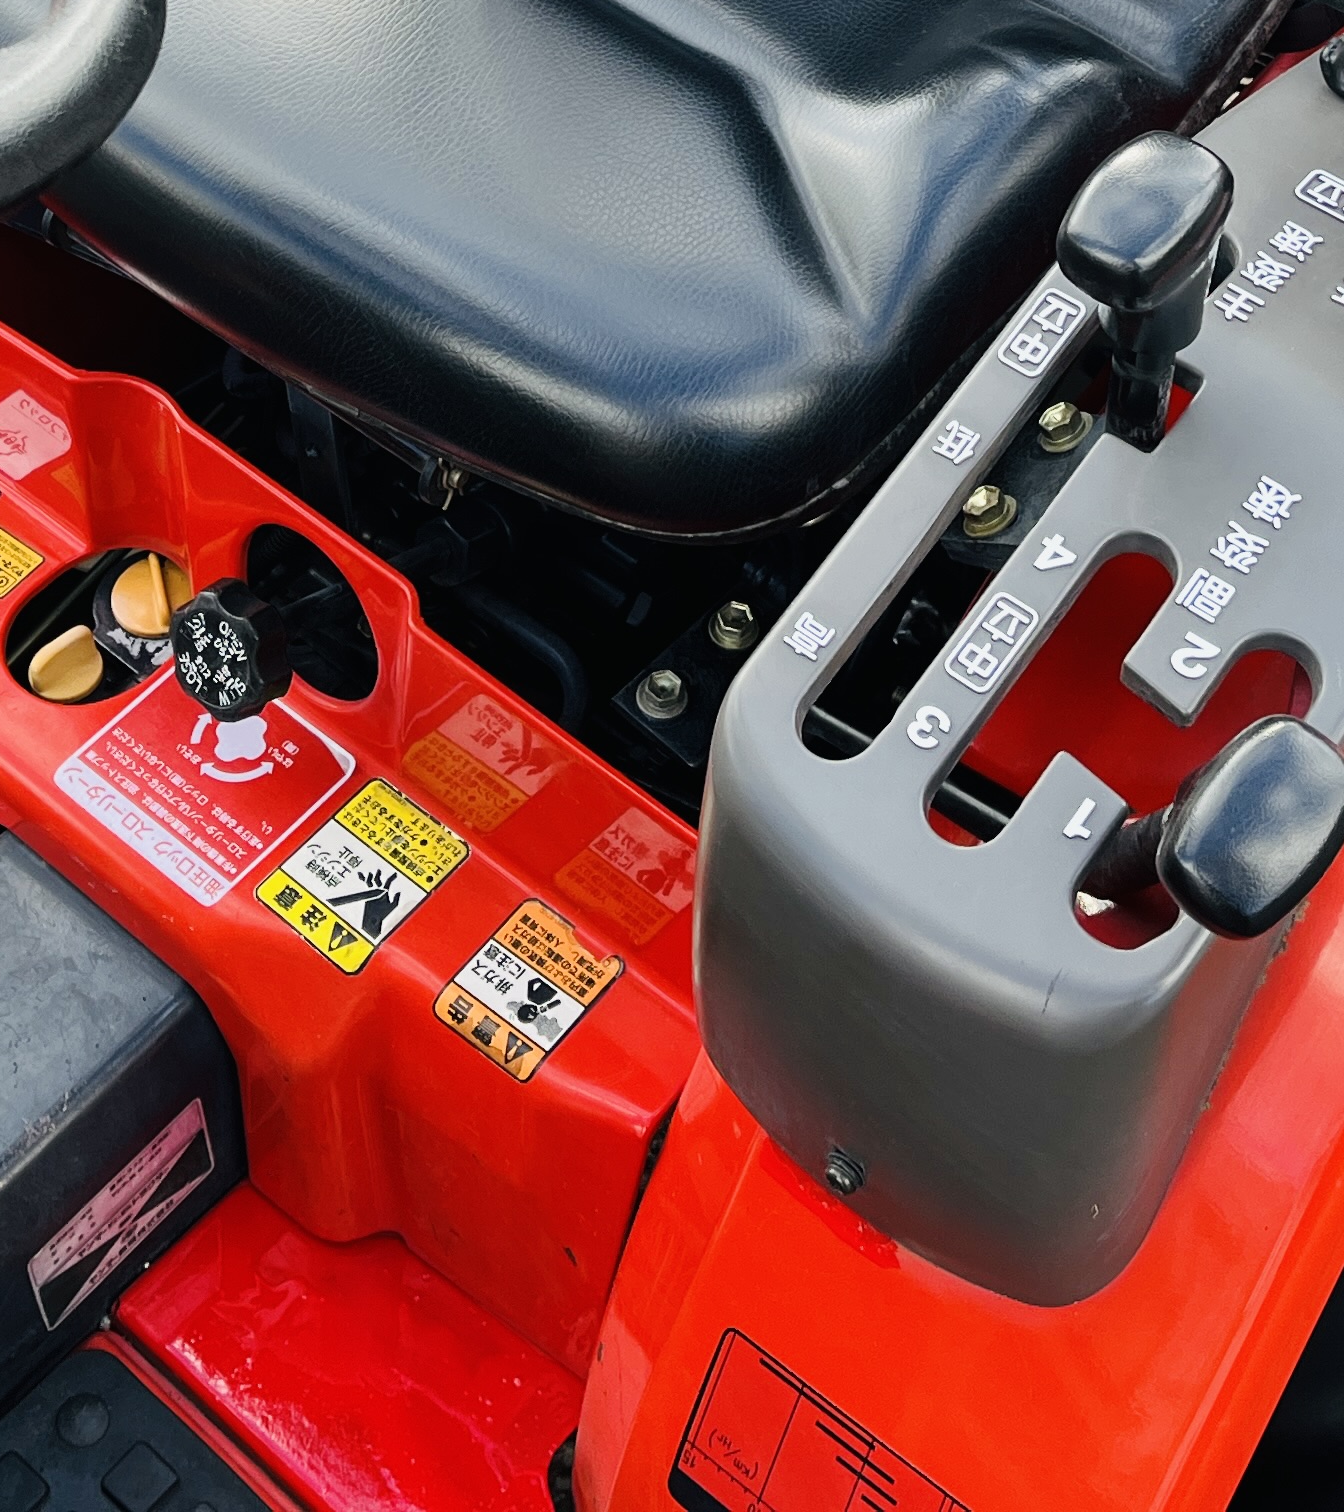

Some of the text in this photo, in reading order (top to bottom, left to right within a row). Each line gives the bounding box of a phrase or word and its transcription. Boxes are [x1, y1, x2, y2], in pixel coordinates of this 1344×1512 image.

[1207, 217, 1323, 329] 主変速
[1003, 286, 1083, 373] 中立
[929, 415, 985, 470] 低
[1027, 527, 1083, 584] 4
[1170, 468, 1307, 626] 副変速
[780, 606, 839, 665] 高
[951, 594, 1034, 684] 中立
[1162, 626, 1222, 686] 2
[899, 697, 956, 755] 3
[62, 760, 224, 900] 油圧ロック・スローリターン
[1058, 794, 1108, 846] 1
[306, 839, 350, 878] エンジン
[336, 844, 362, 868] 停止
[469, 958, 513, 995] 排ガス
[482, 941, 525, 979] に注意
[682, 1450, 696, 1469] 15
